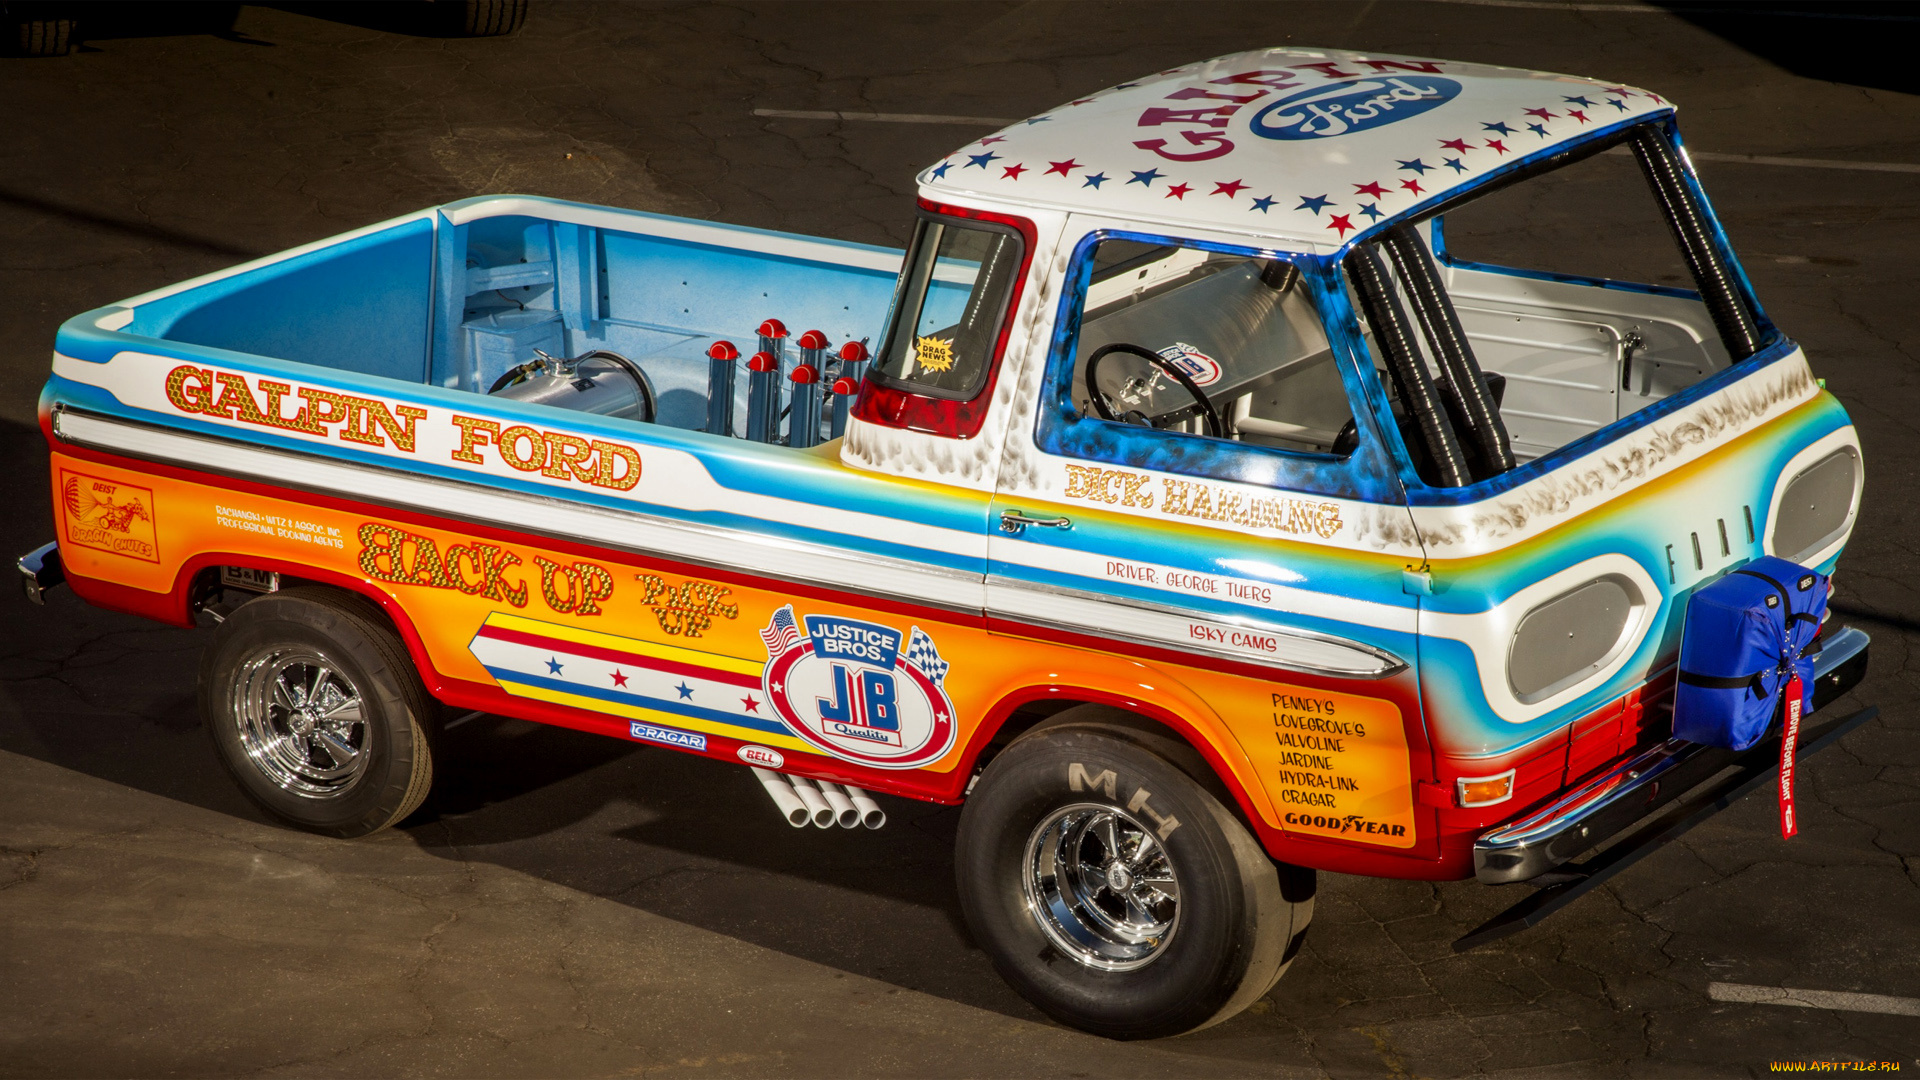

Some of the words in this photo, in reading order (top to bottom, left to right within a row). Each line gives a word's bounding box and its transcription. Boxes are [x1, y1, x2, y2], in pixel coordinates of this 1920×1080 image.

[1132, 60, 1446, 162] GALPIN
[1261, 78, 1438, 136] Ford
[922, 345, 946, 355] DRAG
[922, 352, 946, 361] NEWS
[165, 365, 428, 452] GALPIN
[452, 415, 642, 492] FORD
[92, 482, 117, 495] DEIST
[1064, 464, 1154, 509] DICK
[1161, 478, 1343, 539] HARDING
[216, 516, 276, 536] PROFESSIONAL
[277, 527, 312, 544] BOOKING
[313, 536, 344, 550] AGENTS
[265, 515, 287, 528] WITZ
[295, 521, 326, 535] ASSOC.
[327, 526, 343, 539] INC.
[113, 538, 152, 557] CHUTES
[357, 522, 529, 609] BACK
[532, 555, 614, 617] UP
[1106, 561, 1160, 584] DRIVER:
[1166, 572, 1219, 594] GEORGE
[1225, 582, 1272, 604] TUERS
[633, 573, 740, 620] PICK
[650, 606, 713, 638] UP
[811, 623, 895, 651] JUSTICE
[823, 638, 887, 663] BROS.
[1189, 624, 1227, 643] ISKY
[1231, 632, 1278, 653] CAMS
[816, 662, 901, 732] JB
[1271, 693, 1336, 716] PENNEY'S
[1273, 712, 1366, 738] LOVEGROVE'S
[1788, 698, 1802, 736] REMOVE
[633, 726, 703, 747] CRAGAR
[834, 722, 889, 742] Quality
[1275, 731, 1346, 753] VALVOLINE
[746, 749, 775, 764] BELL
[1278, 751, 1335, 770] JARDINE
[1783, 735, 1796, 770] BEFORE
[1279, 770, 1360, 792] HYDRA-LINK
[1781, 768, 1791, 801] FLIGHT
[1281, 789, 1337, 808] CRAGAR
